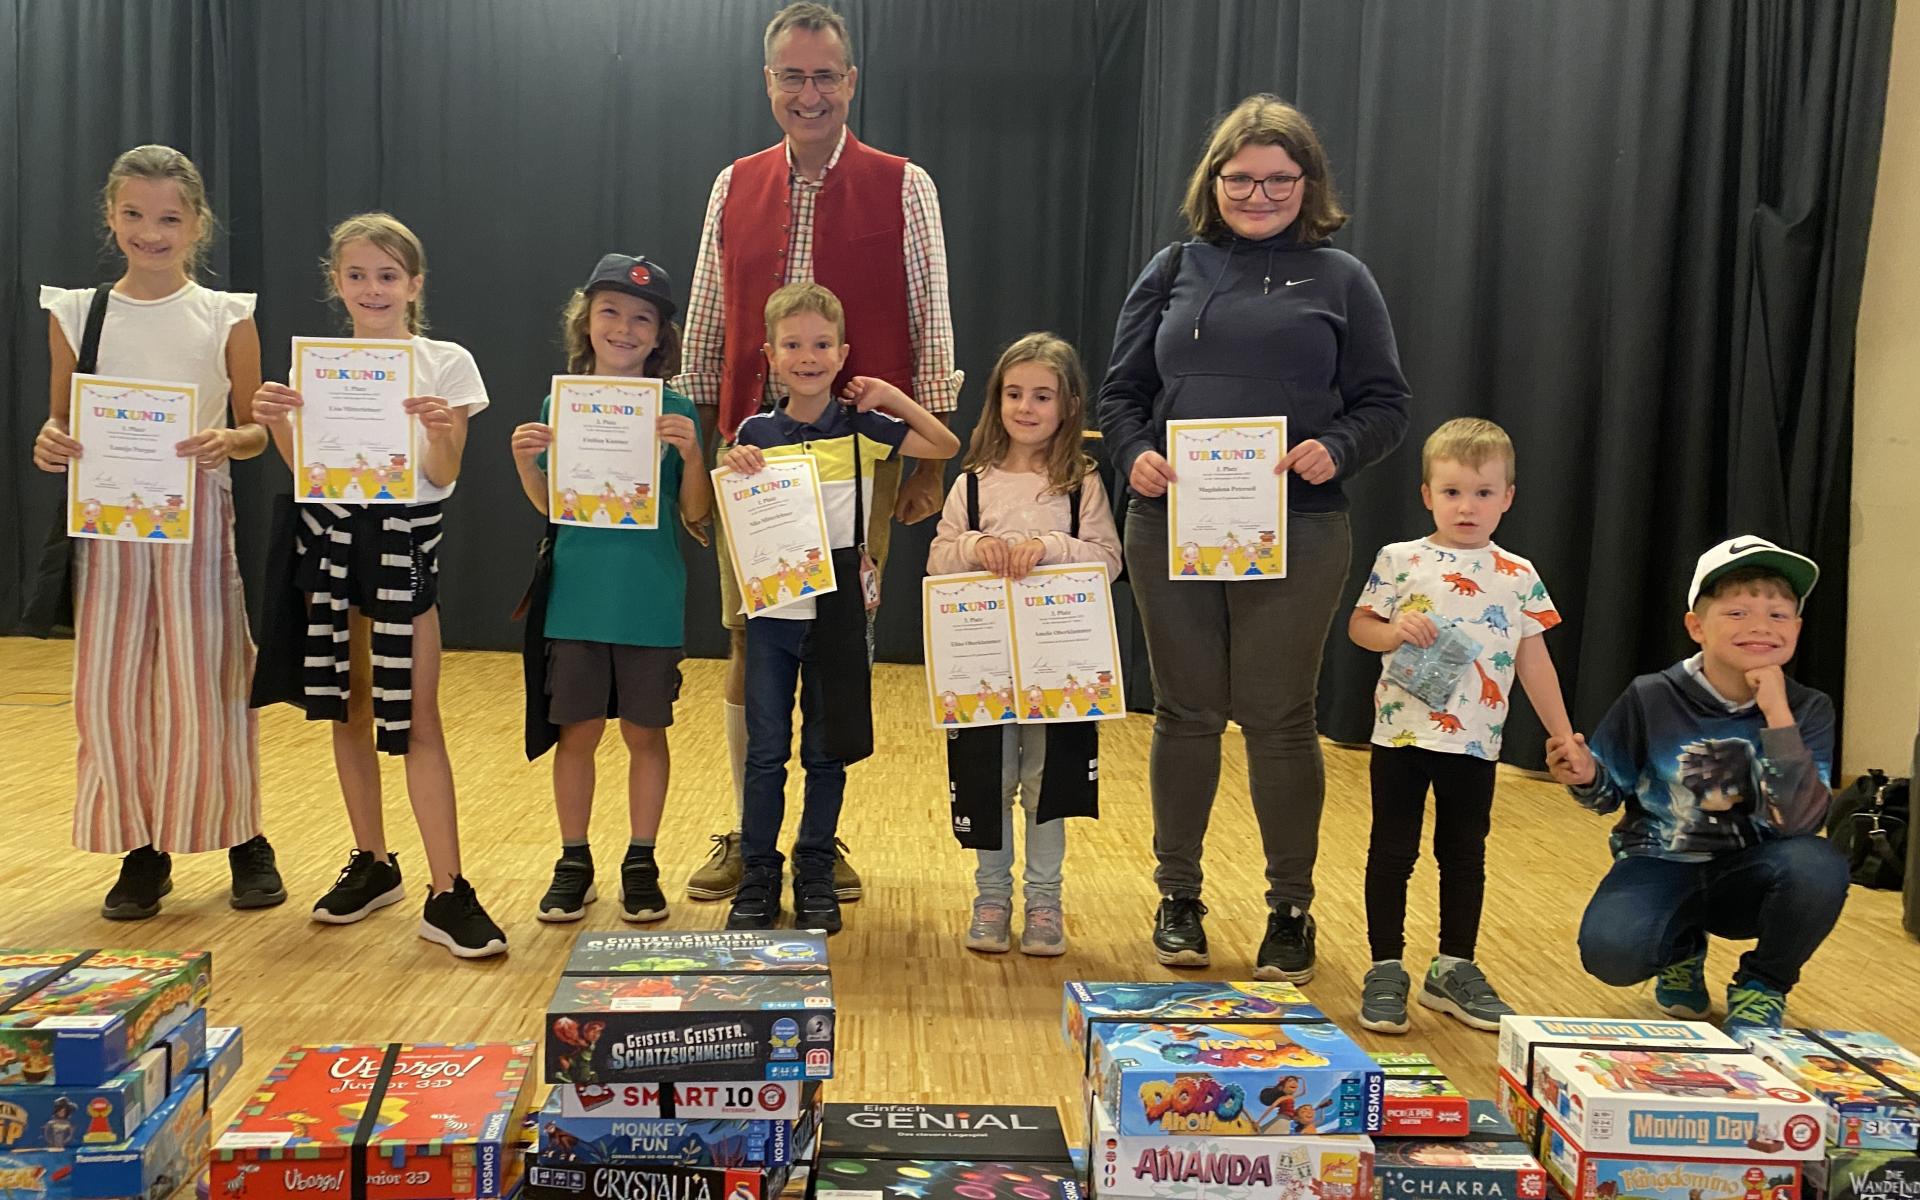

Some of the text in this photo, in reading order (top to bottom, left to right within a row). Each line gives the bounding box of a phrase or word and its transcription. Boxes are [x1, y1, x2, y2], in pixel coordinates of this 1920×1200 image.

[315, 368, 397, 382] URKUNDE
[92, 406, 177, 424] URKUNDE
[570, 403, 645, 417] URKUNDE
[1188, 449, 1267, 461] URKUNDE
[733, 478, 801, 502] URKUNDE
[940, 600, 1006, 614] URKUNDE
[1024, 592, 1096, 607] URKUNDE
[626, 1024, 748, 1049] GEISTER. GEISTER.
[1541, 1021, 1697, 1039] Moving Day
[623, 1086, 719, 1107] SMART
[724, 1087, 754, 1107] 10
[1138, 1077, 1246, 1126] DODO
[1366, 1075, 1381, 1131] KOSMOS
[863, 1104, 926, 1113] Einfach
[611, 1122, 688, 1136] MONKEY
[1633, 1113, 1757, 1144] Moving Day
[1865, 1120, 1905, 1135] SKY
[631, 1138, 669, 1151] FUN
[774, 1119, 785, 1162] KOSMOS
[482, 1146, 495, 1194] KOSMOS
[1618, 1165, 1740, 1193] Kingdomino
[1884, 1169, 1905, 1180] DIE
[284, 1168, 345, 1192] Ubongo!
[1401, 1179, 1503, 1197] CHAKRA
